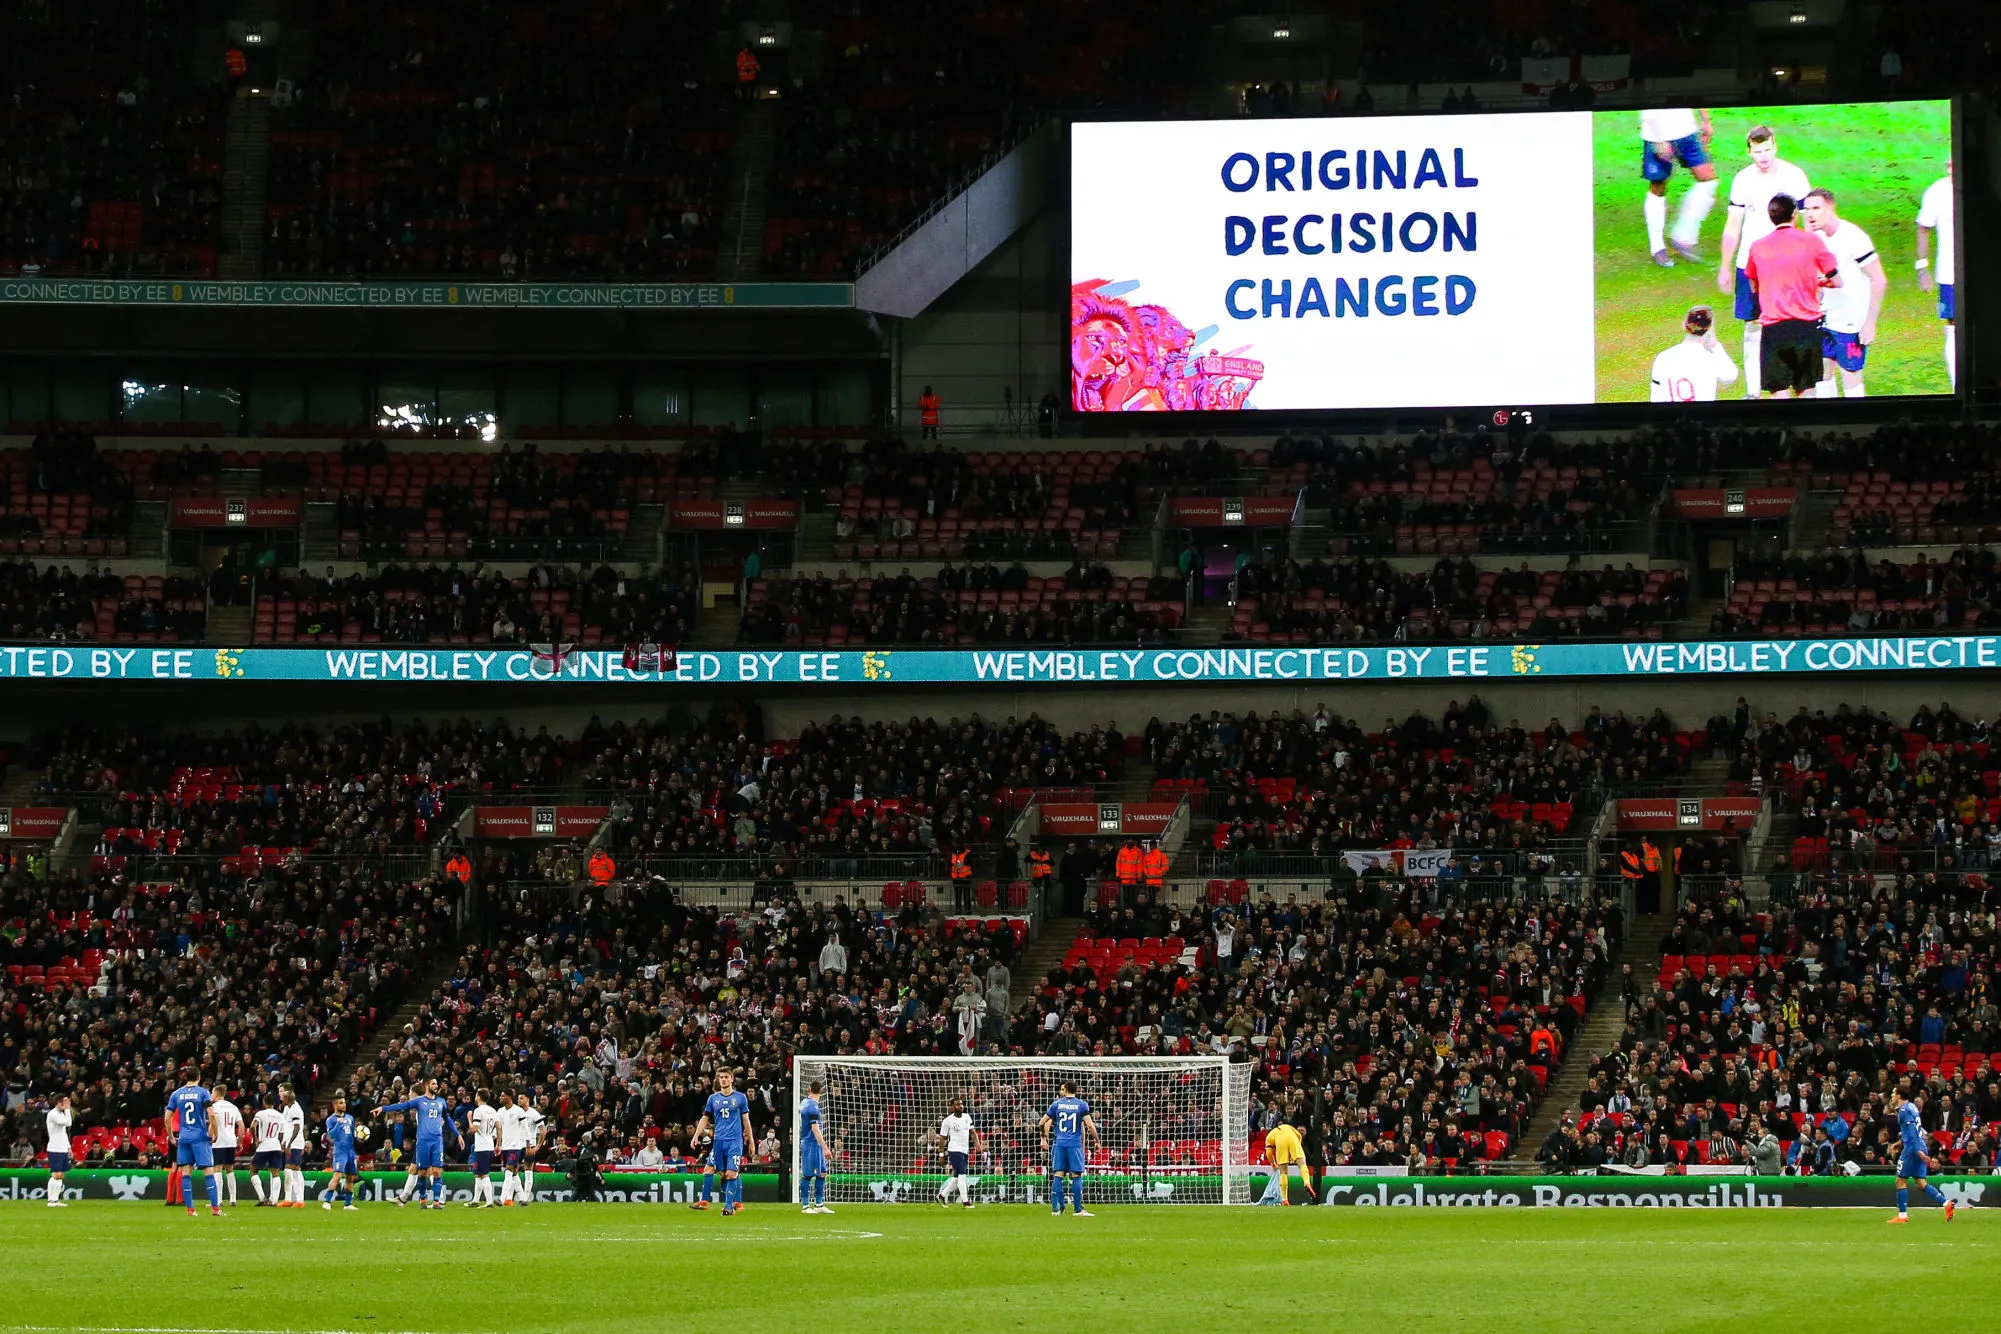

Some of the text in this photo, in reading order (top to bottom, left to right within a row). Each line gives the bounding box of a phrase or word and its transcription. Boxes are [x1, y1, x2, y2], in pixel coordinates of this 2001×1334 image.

[1221, 148, 1479, 192] ORIGINAL
[1224, 211, 1478, 256] DECISION
[5, 284, 167, 300] CONNECTED BY EE
[190, 286, 443, 303] WEMBLEY CONNECTED BY EE
[465, 288, 718, 303] WEMBLEY CONNECTED BY EE
[1225, 274, 1477, 320] CHANGED
[1727, 494, 1743, 503] 240
[229, 504, 244, 512] 237
[727, 506, 742, 514] 238
[1226, 503, 1241, 511] 239
[0, 647, 193, 678] TED BY EE
[973, 648, 1489, 680] WEMBLEY CONNECTED BY EE
[1623, 641, 1796, 672] WEMBLEY
[326, 651, 497, 679] WEMBLEY
[506, 652, 721, 680] CNEED
[739, 653, 783, 681] BY
[799, 653, 840, 681] EE
[1102, 810, 1118, 818] 133
[1681, 805, 1698, 813] 134
[537, 814, 552, 822] 132
[1408, 857, 1446, 870] BCFC
[184, 1101, 196, 1125] 2
[224, 1111, 234, 1127] 14
[428, 1109, 438, 1118] 20
[720, 1108, 730, 1118] 15
[266, 1122, 279, 1138] 10
[1059, 1112, 1077, 1133] 21
[732, 1155, 741, 1165] 15
[1326, 1183, 1521, 1206] Celebrate
